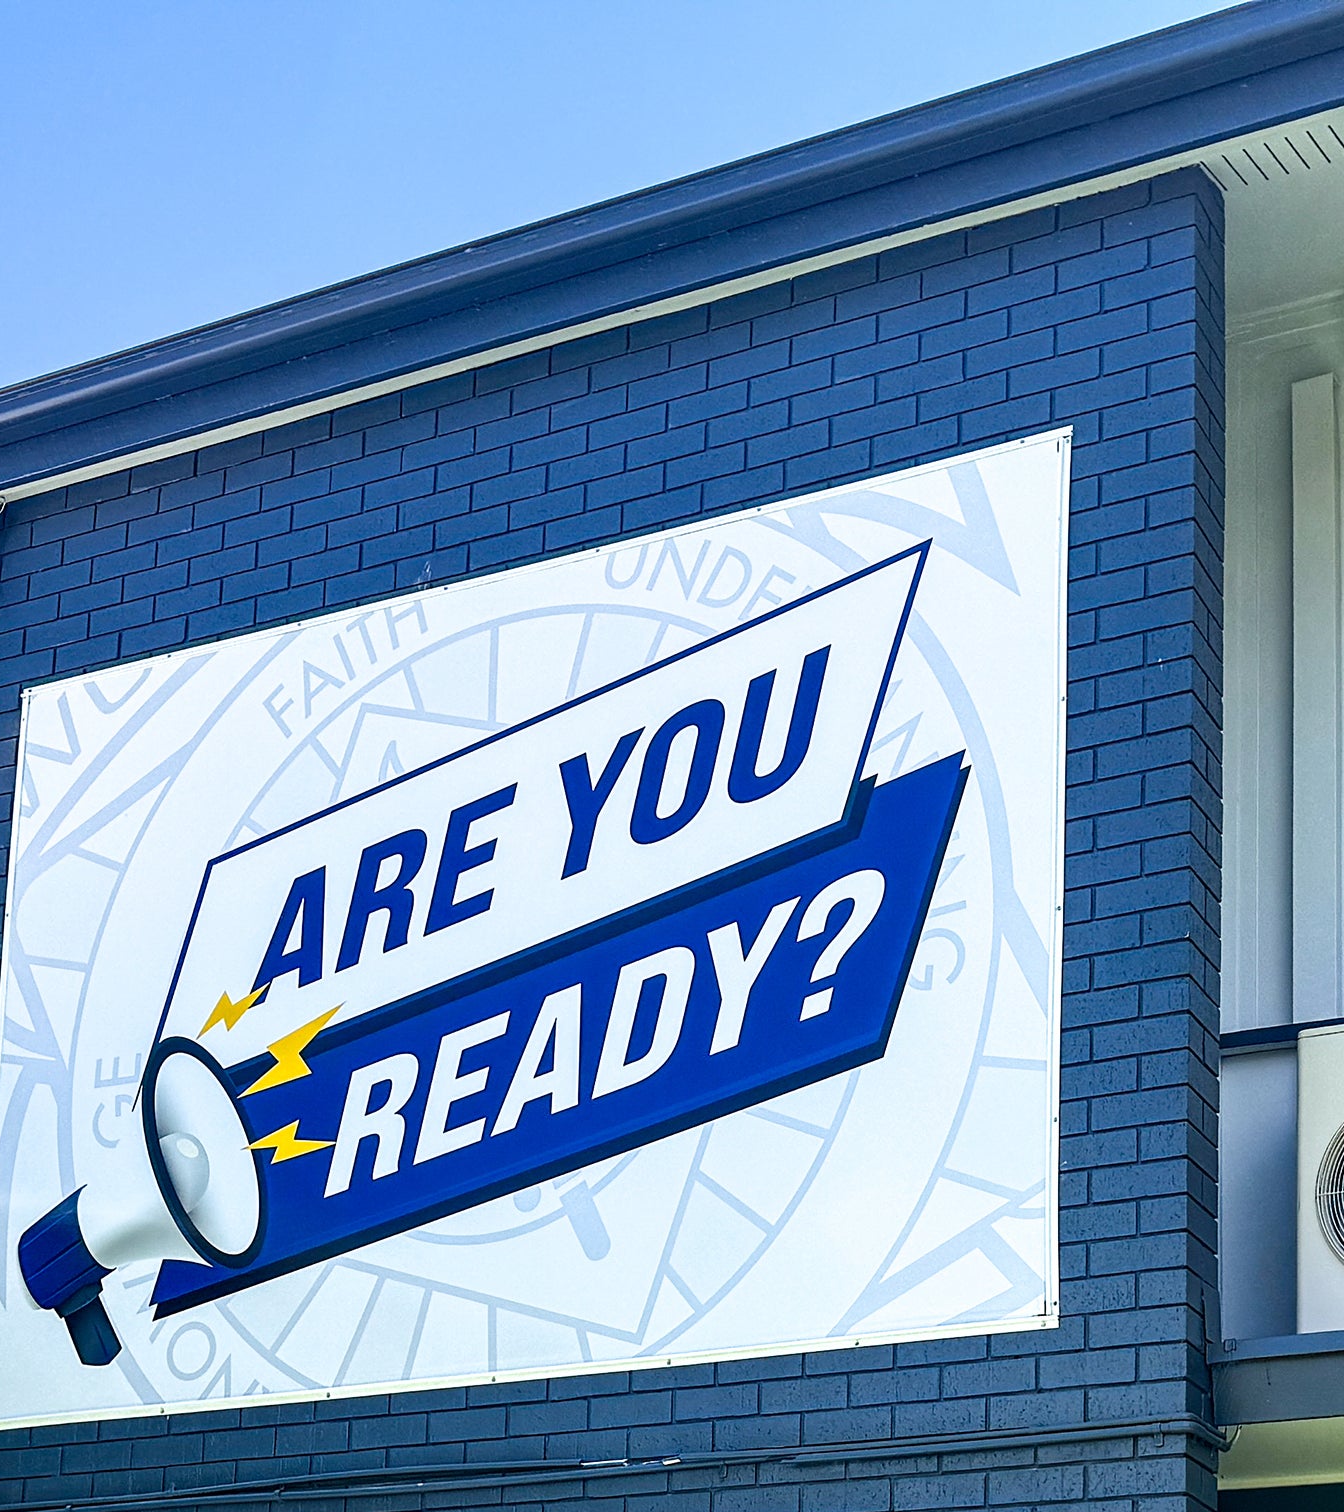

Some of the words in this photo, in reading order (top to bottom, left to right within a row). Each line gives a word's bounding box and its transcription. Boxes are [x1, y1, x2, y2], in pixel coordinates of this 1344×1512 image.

[248, 782, 518, 1009] ARE
[558, 643, 832, 881] YOU
[262, 599, 428, 739] FAITH
[323, 869, 886, 1199] READY?
